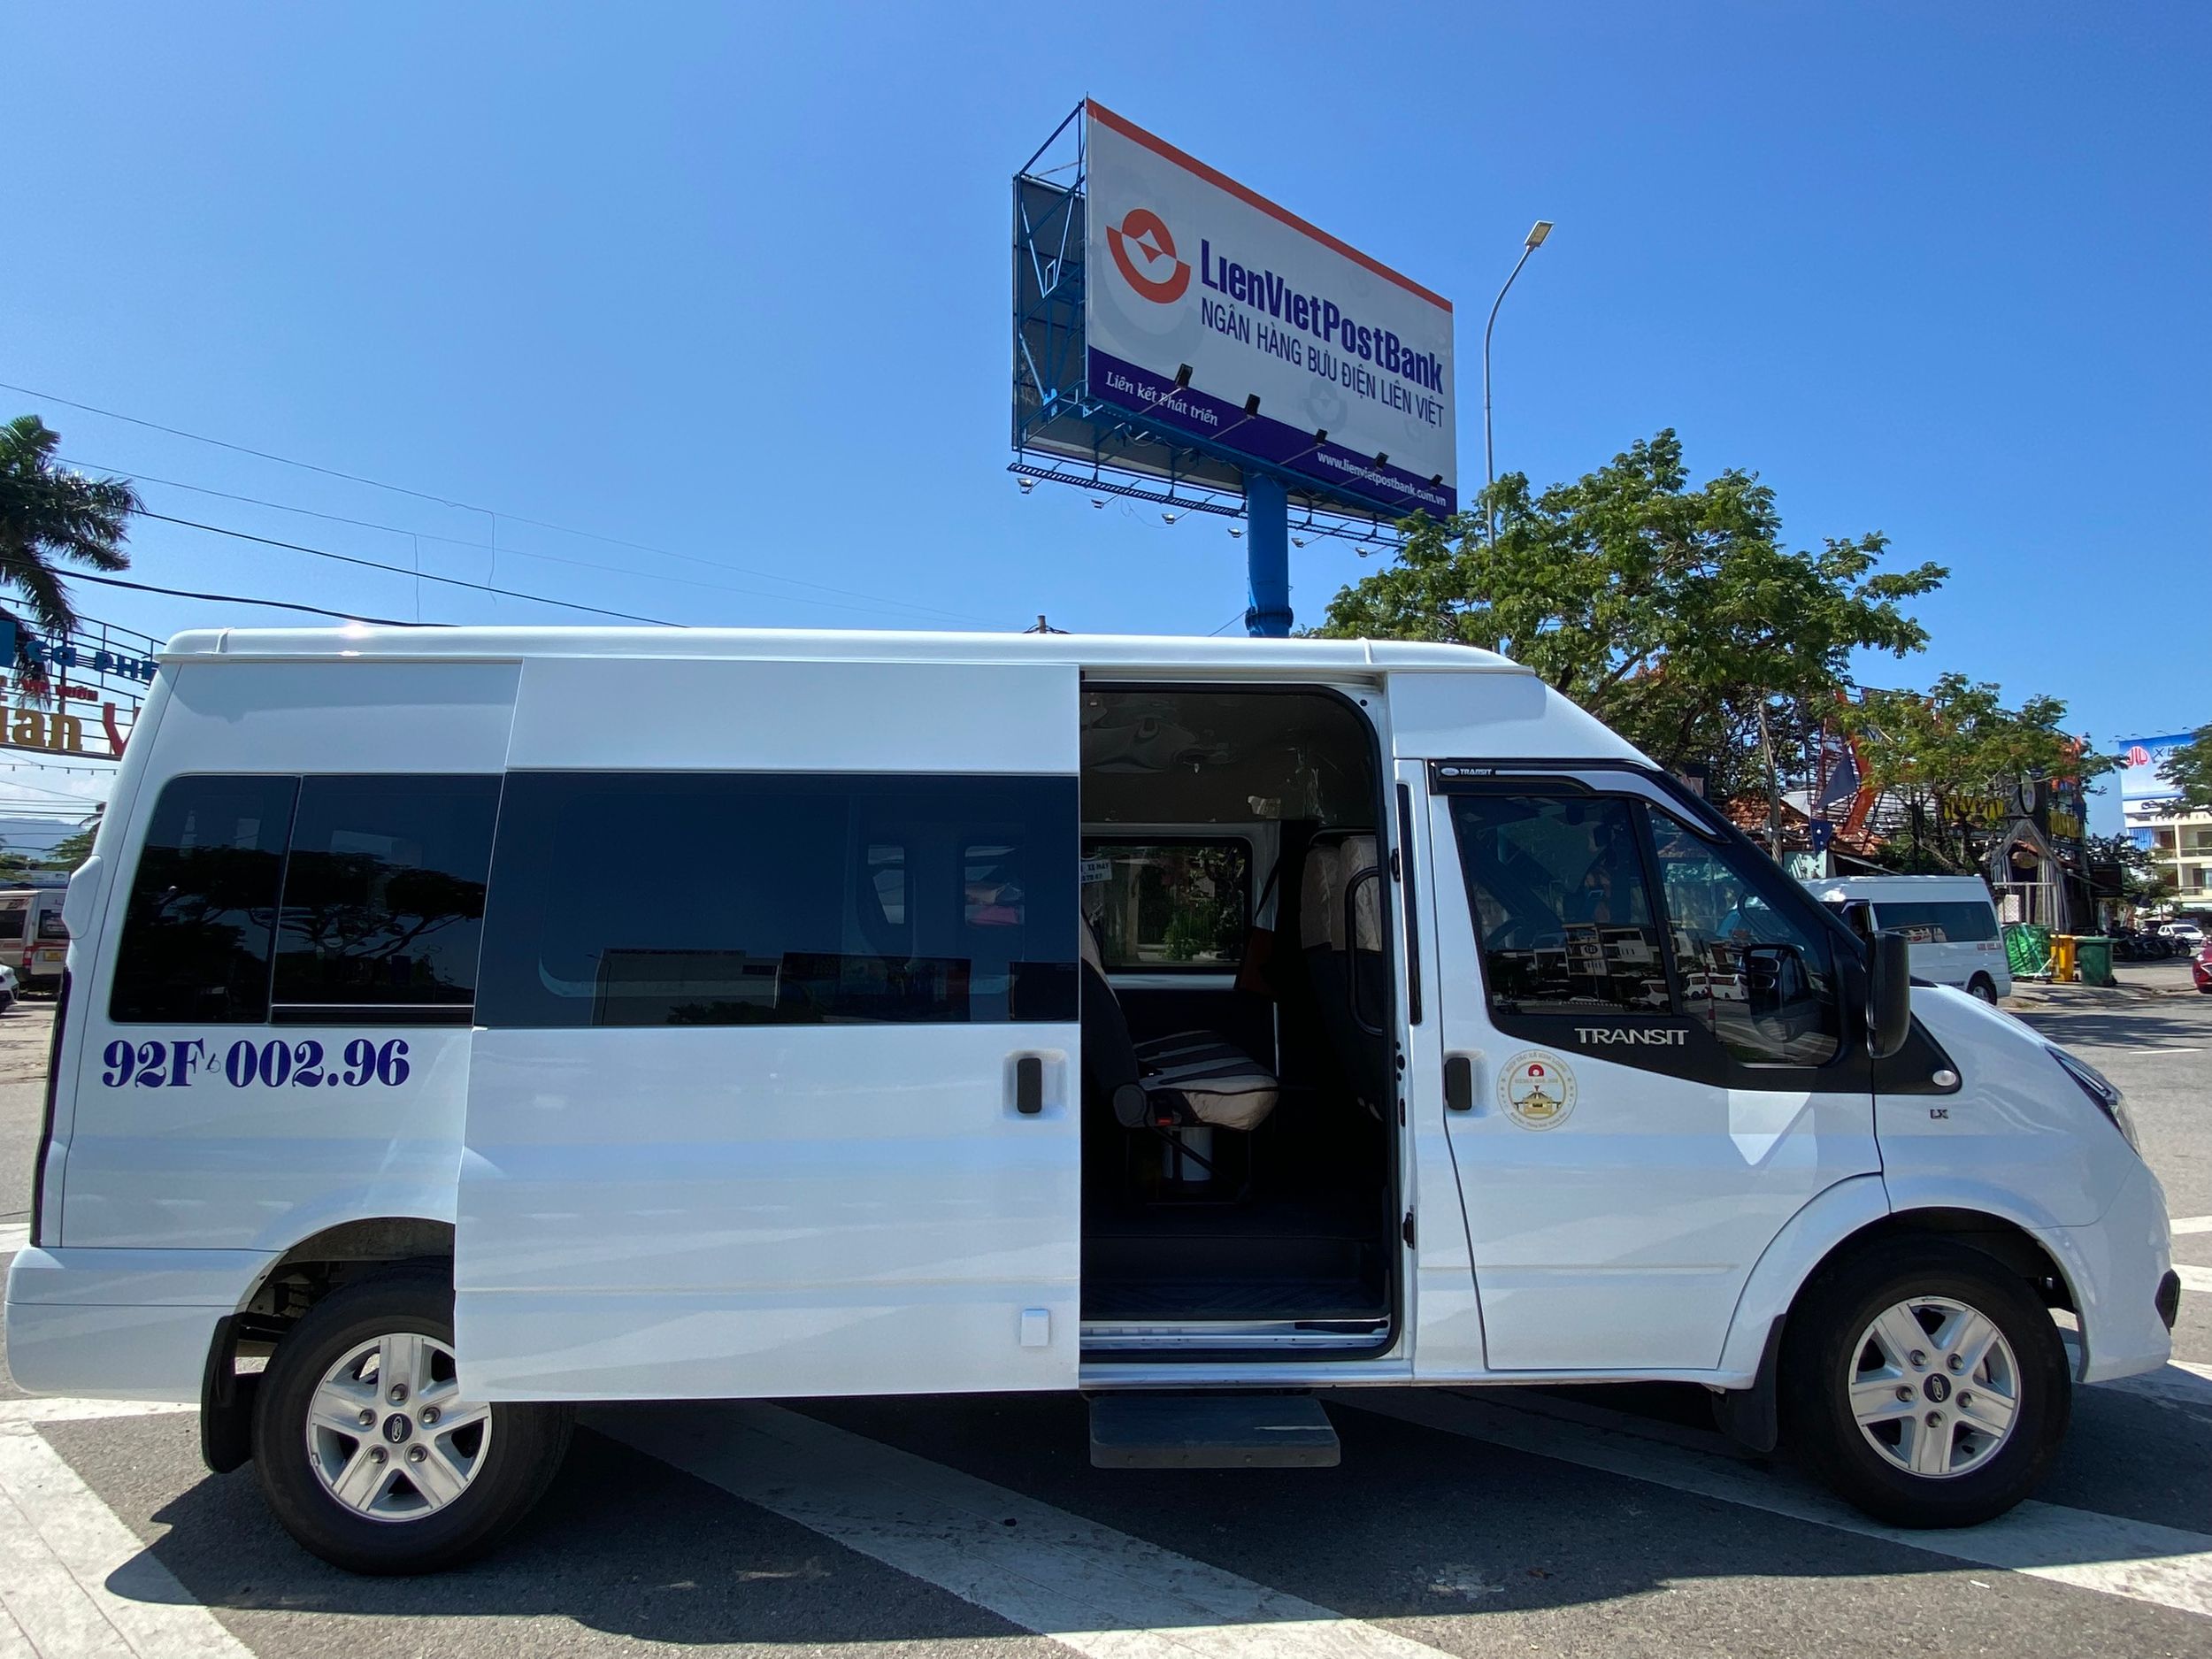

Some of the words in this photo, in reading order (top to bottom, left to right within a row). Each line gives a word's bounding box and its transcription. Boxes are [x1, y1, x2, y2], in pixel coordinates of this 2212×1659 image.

[1202, 239, 1444, 395] LienVietPostBank
[1202, 296, 1249, 345] NGÂN
[1257, 321, 1302, 367] HÀNG
[1308, 344, 1337, 382] BƯU
[1341, 363, 1376, 400] ĐIỆN
[1381, 380, 1411, 415] LIÊN
[1416, 395, 1445, 429] VIỆT
[1106, 371, 1133, 395] Liên
[1137, 382, 1157, 403] kết
[1160, 392, 1187, 415] Phát
[1317, 451, 1447, 507] www.lienvietpostbank.com.vn
[1574, 1027, 1689, 1045] TRANSIT
[1930, 1108, 1949, 1119] LX
